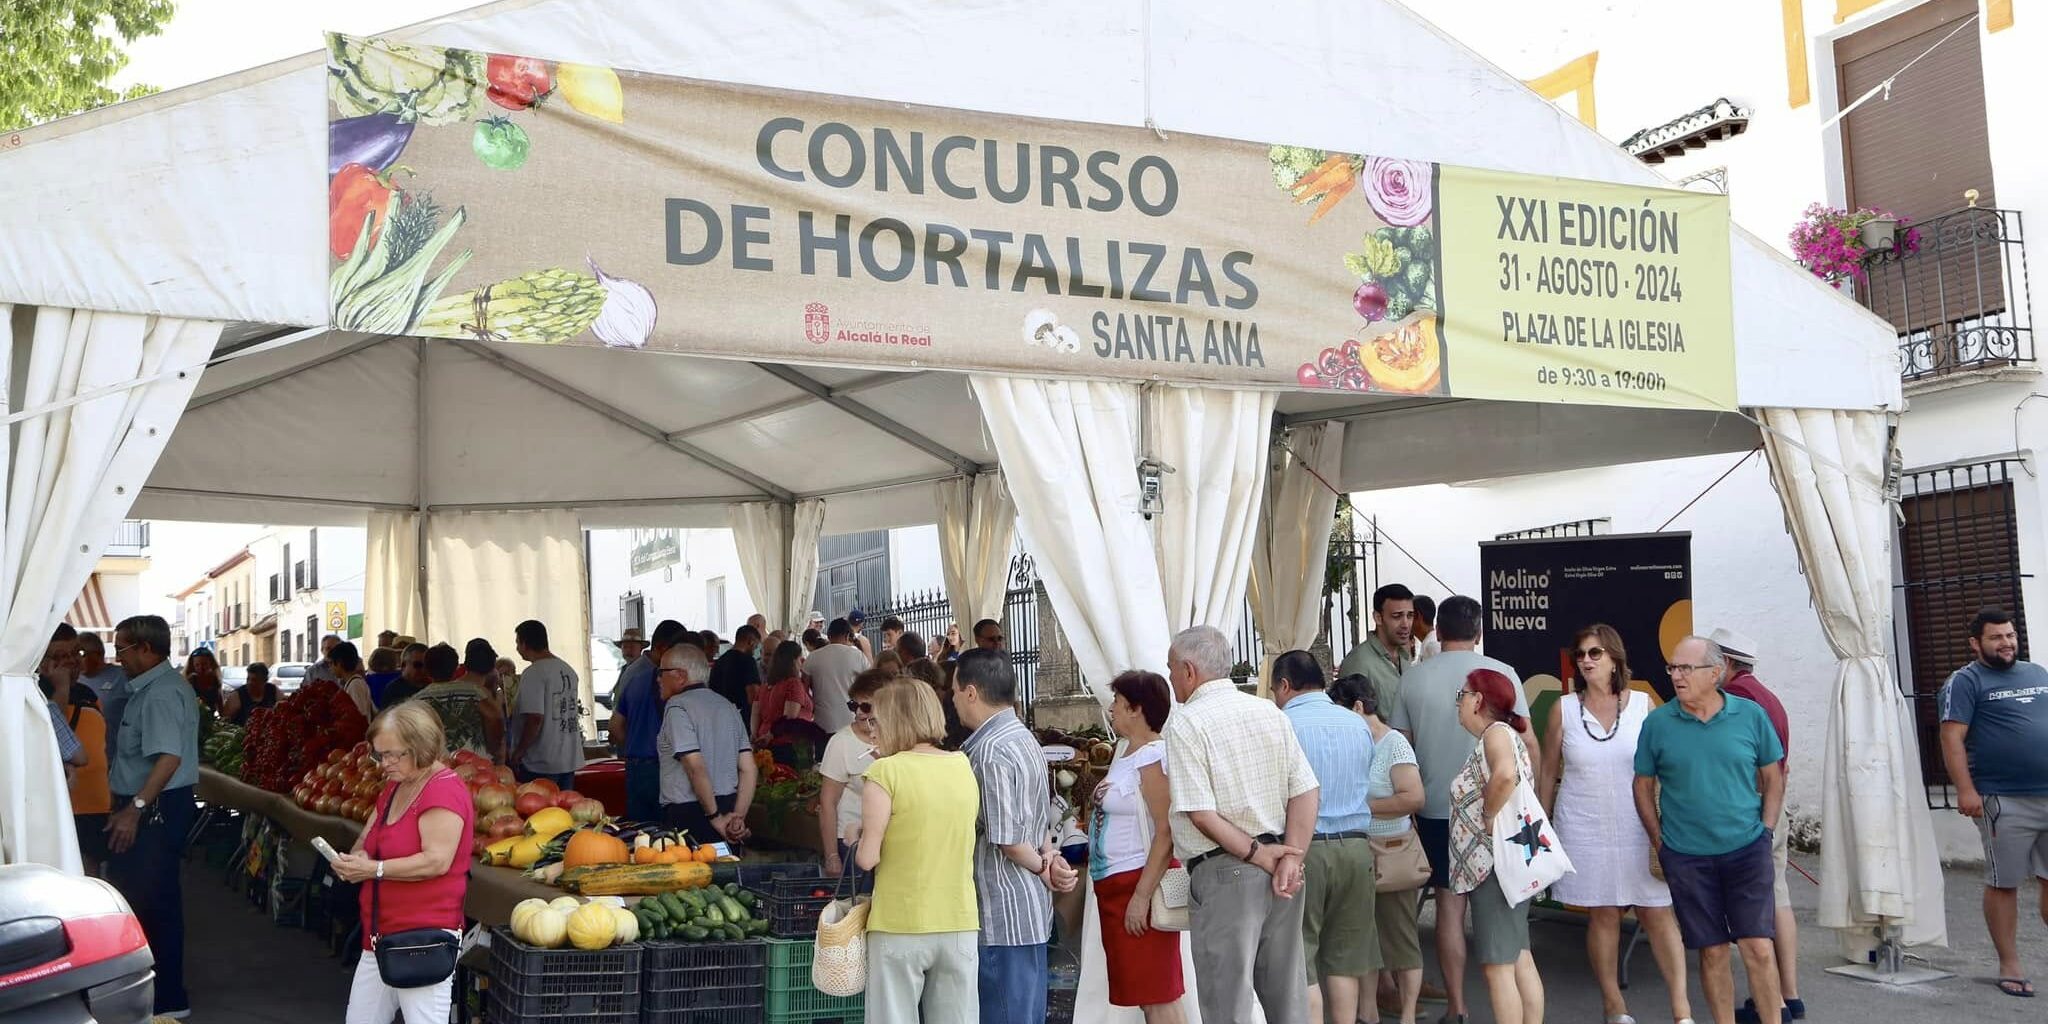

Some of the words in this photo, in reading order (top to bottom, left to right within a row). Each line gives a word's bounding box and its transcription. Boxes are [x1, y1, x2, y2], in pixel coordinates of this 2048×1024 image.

[756, 117, 1179, 217] CONCURSO
[1496, 195, 1548, 243] XXI
[1558, 199, 1679, 254] EDICIÓN
[665, 198, 774, 273] DE
[799, 210, 1260, 310] HORTALIZAS
[1499, 252, 1520, 291] 31
[1536, 256, 1618, 298] AGOSTO
[1635, 263, 1682, 302] 2024
[837, 330, 882, 344] Alcalá
[885, 333, 898, 344] la
[901, 334, 931, 346] Real
[1093, 311, 1195, 364] SANTA
[1203, 319, 1265, 368] ANA
[1503, 311, 1561, 345] PLAZA
[1564, 316, 1587, 347] DE
[1592, 318, 1615, 349] LA
[1619, 319, 1685, 353] IGLESIA
[1537, 366, 1558, 385] de
[1562, 367, 1597, 387] 9:30
[1601, 373, 1611, 388] a
[1615, 370, 1666, 391] 19:00h
[1490, 570, 1550, 590] Molino
[1491, 590, 1549, 610] Ermita
[1492, 610, 1547, 631] Nueva
